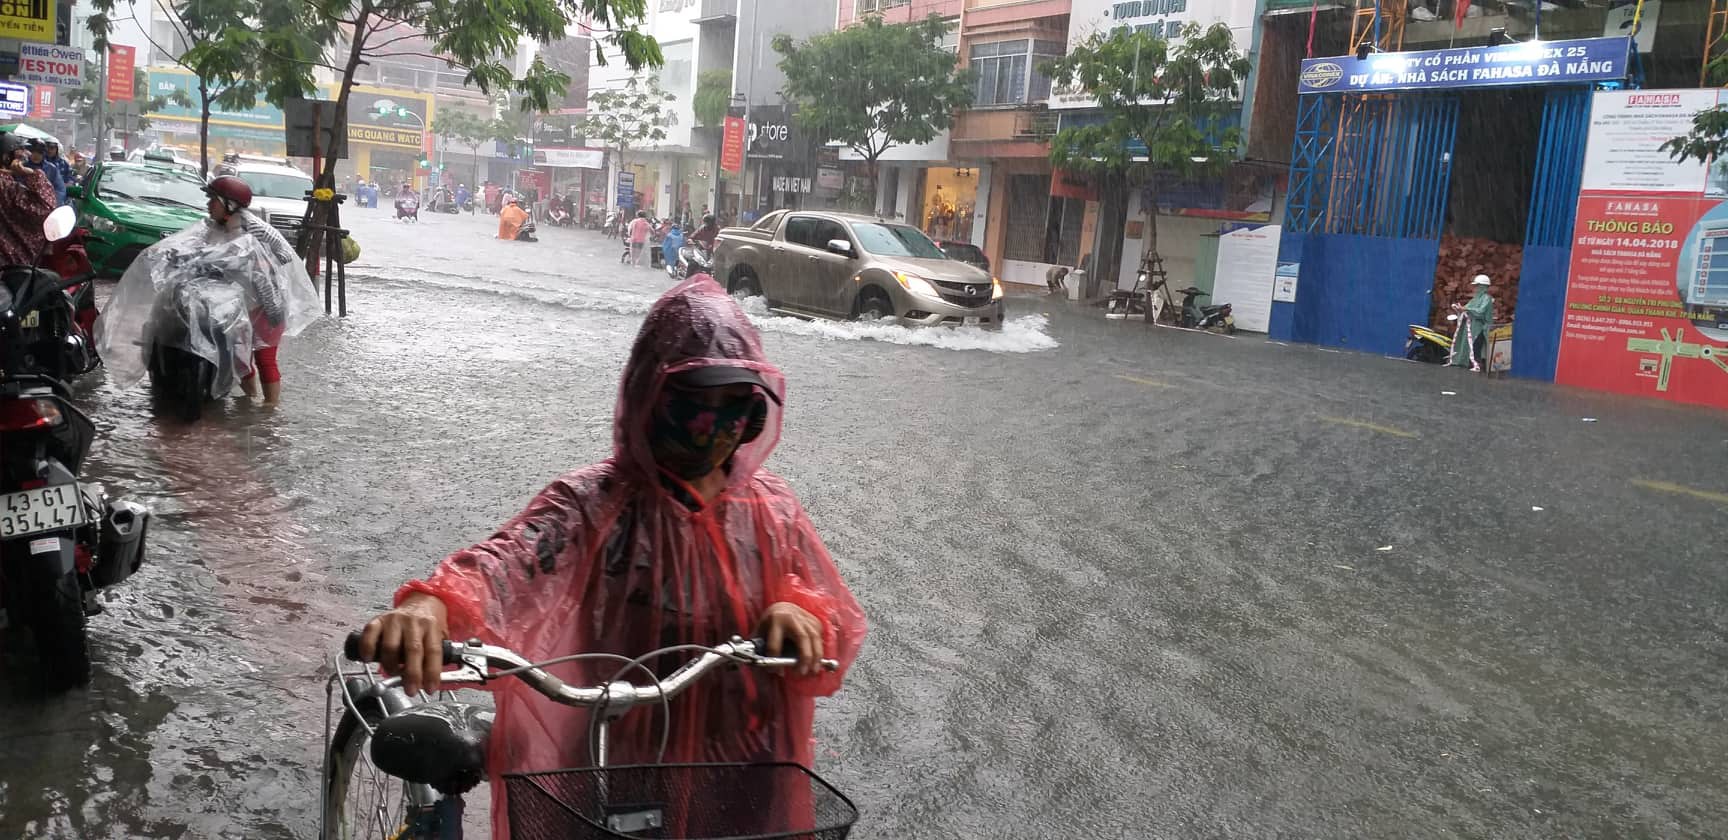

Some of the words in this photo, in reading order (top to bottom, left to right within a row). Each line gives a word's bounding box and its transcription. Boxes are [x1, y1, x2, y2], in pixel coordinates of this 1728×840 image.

[1113, 1, 1141, 20] TOUR
[1445, 50, 1480, 66] PHẦN
[1567, 46, 1587, 57] 25
[1397, 69, 1426, 84] NHÀ
[1431, 67, 1468, 82] SÁCH
[1473, 65, 1534, 80] FAHASA
[1537, 61, 1560, 77] ĐÀ
[1628, 95, 1680, 105] FAHASA
[365, 130, 395, 142] QUANG
[1607, 202, 1659, 212] FAHASA
[1587, 219, 1639, 234] THÔNG
[1641, 221, 1674, 235] BÁO
[1617, 238, 1678, 249] 14.04.2018
[7, 488, 64, 513] 43-G1
[2, 505, 77, 536] 354.47
